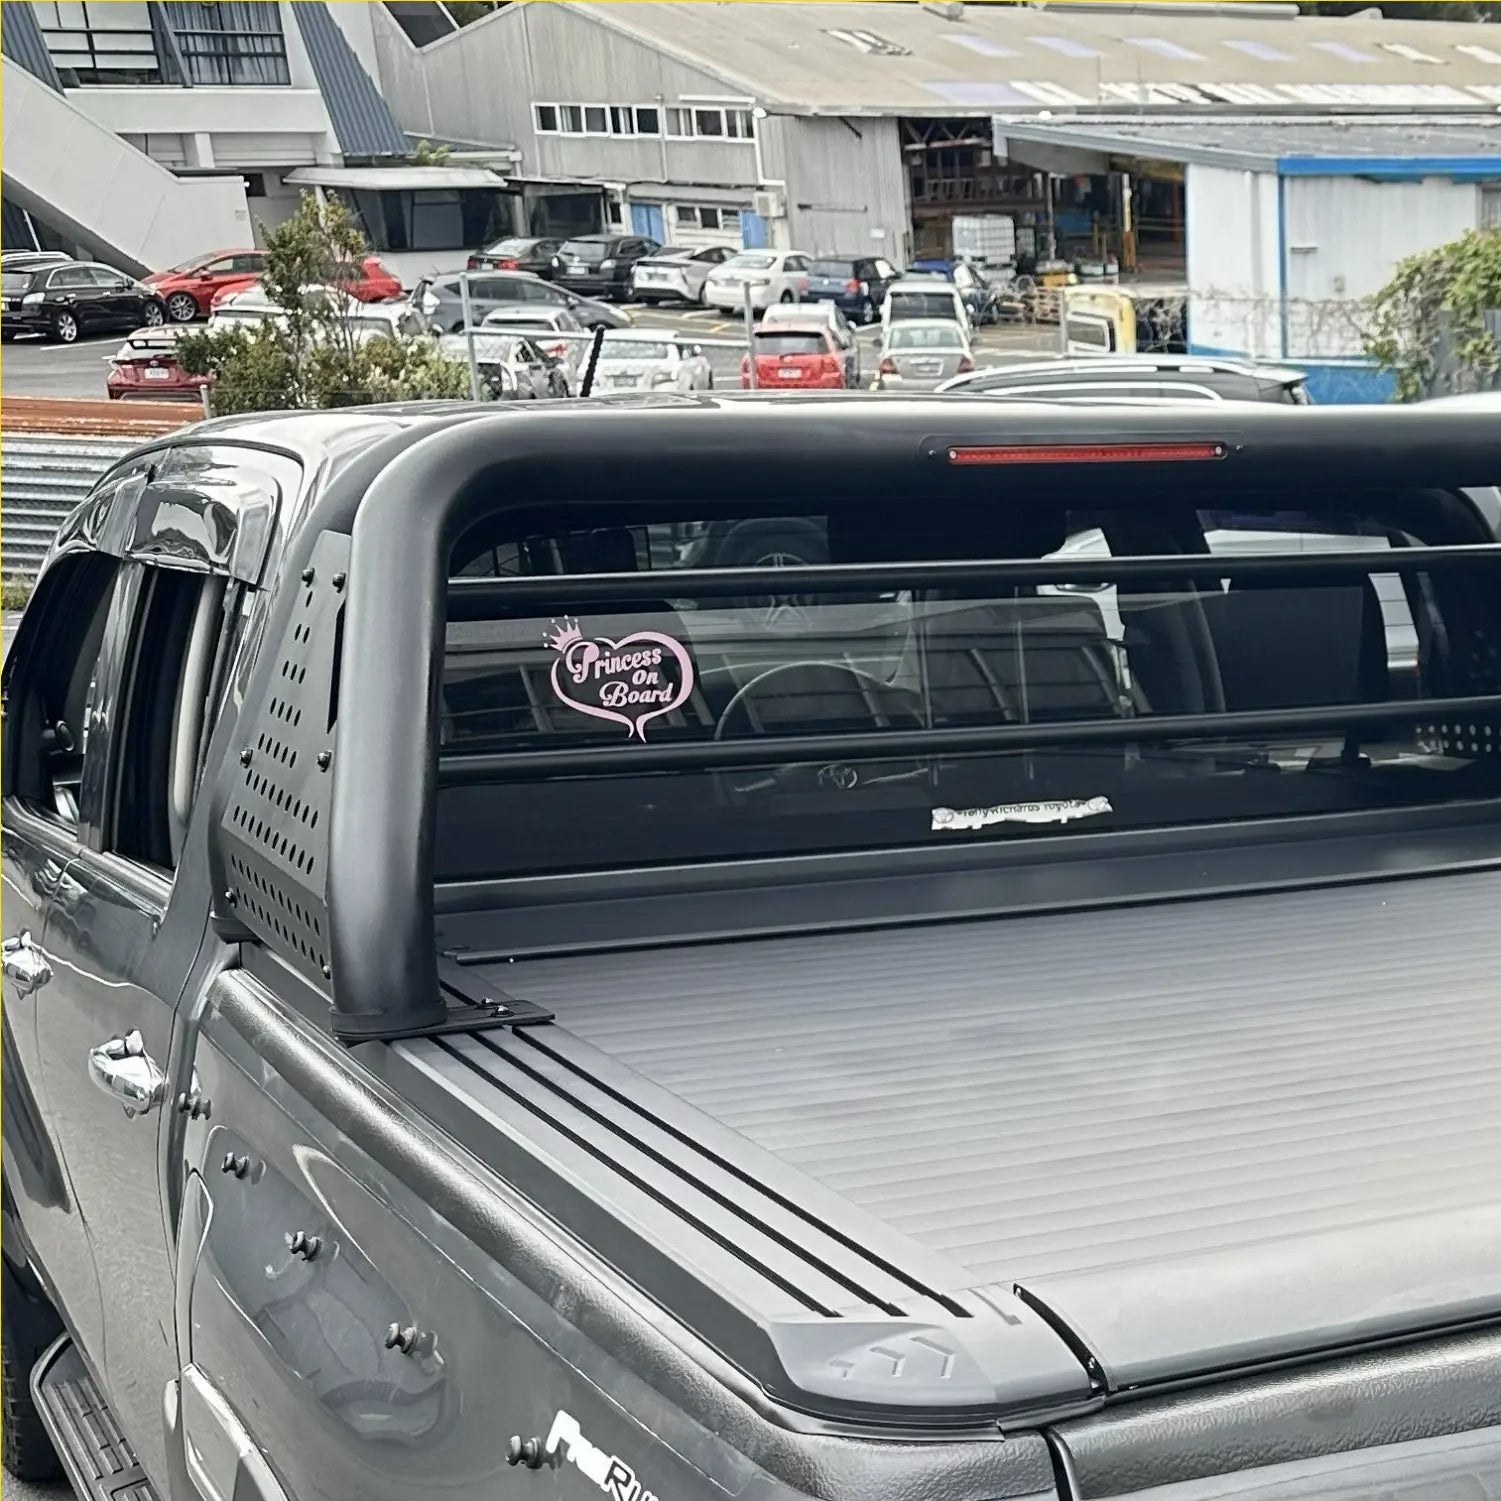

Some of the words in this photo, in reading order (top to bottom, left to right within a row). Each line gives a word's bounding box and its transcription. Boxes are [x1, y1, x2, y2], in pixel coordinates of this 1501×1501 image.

[565, 641, 663, 684] Princess
[632, 668, 660, 686] On
[599, 680, 674, 708] Board
